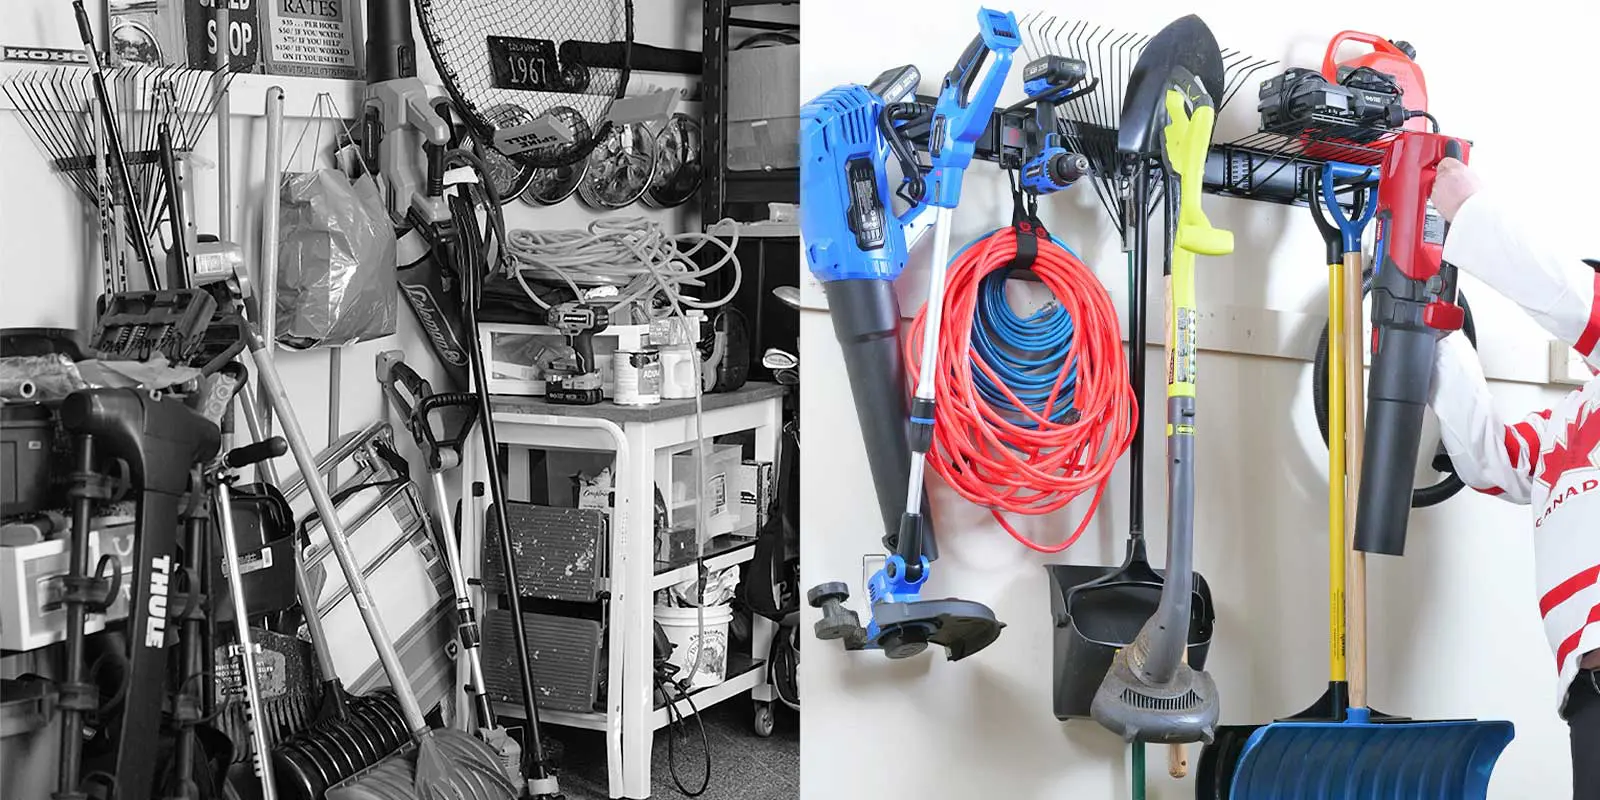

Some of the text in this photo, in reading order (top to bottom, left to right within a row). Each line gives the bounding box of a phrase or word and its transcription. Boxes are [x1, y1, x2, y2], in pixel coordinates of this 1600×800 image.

[283, 0, 338, 17] RATES
[207, 19, 252, 56] SOP
[508, 55, 546, 84] 1967
[407, 289, 449, 352] Coleman
[145, 555, 170, 648] THULE
